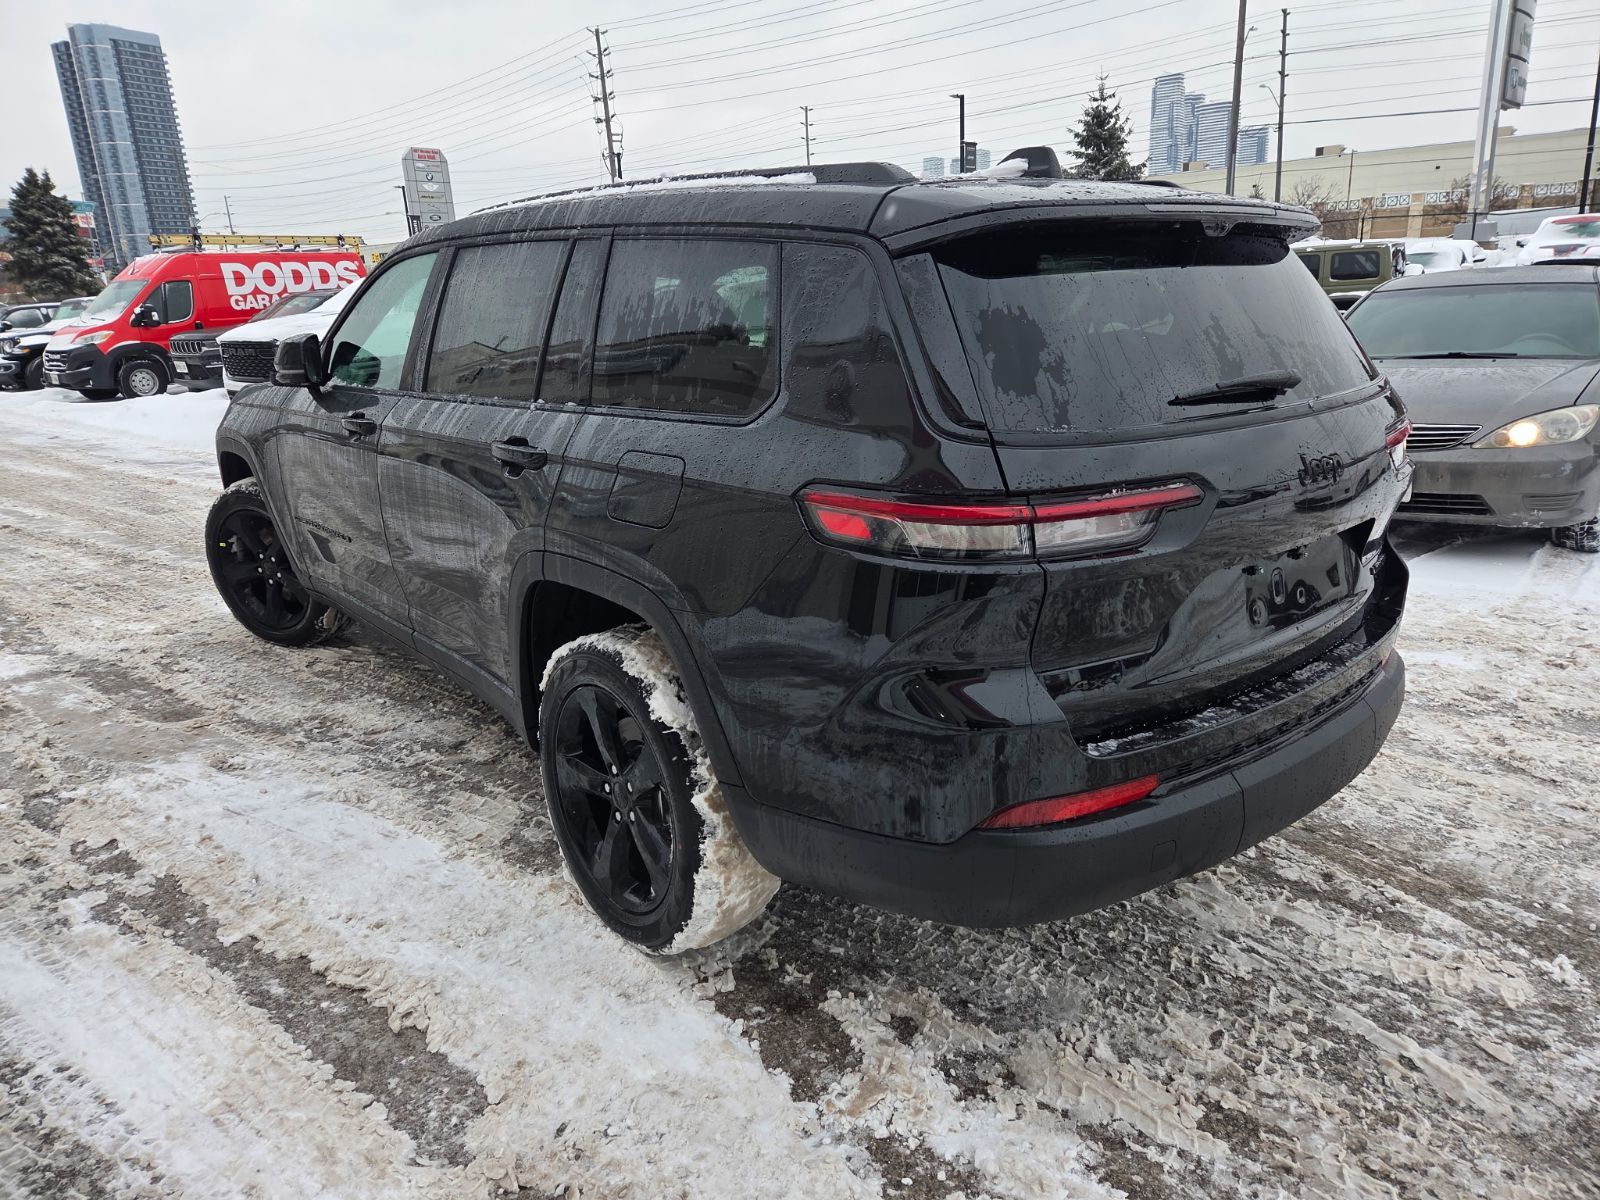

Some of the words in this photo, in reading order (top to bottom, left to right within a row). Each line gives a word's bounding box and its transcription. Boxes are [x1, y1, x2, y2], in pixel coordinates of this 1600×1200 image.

[220, 261, 360, 295] DODDS
[230, 293, 290, 310] GARA
[1298, 453, 1344, 487] Jeep
